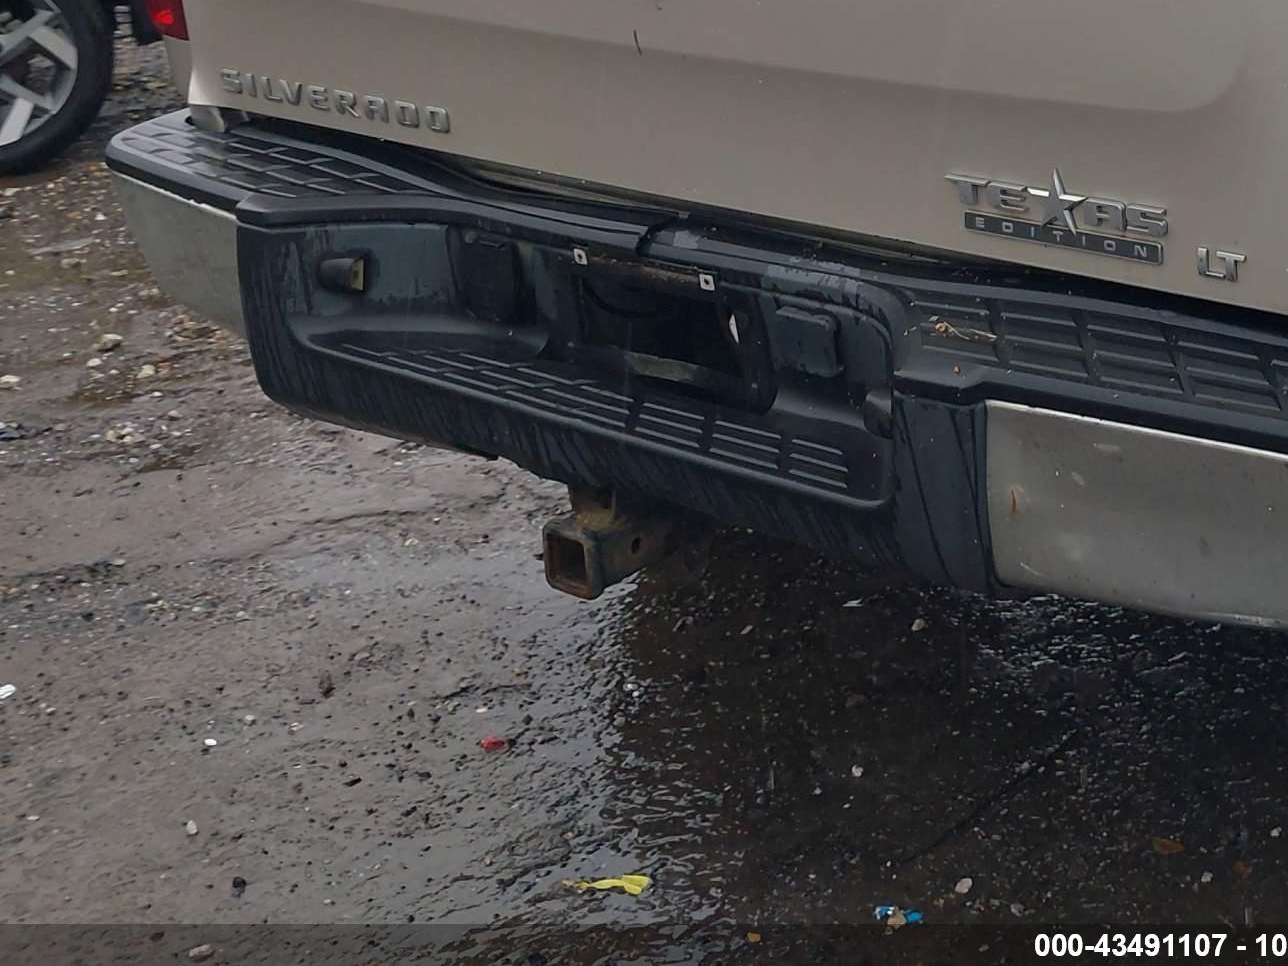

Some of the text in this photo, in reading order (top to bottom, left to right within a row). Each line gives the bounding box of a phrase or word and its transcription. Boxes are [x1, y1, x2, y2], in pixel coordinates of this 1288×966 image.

[219, 68, 450, 134] SILVERADO
[944, 168, 1169, 236] TEXAS
[974, 216, 1148, 258] EDITION
[1197, 247, 1247, 282] LT
